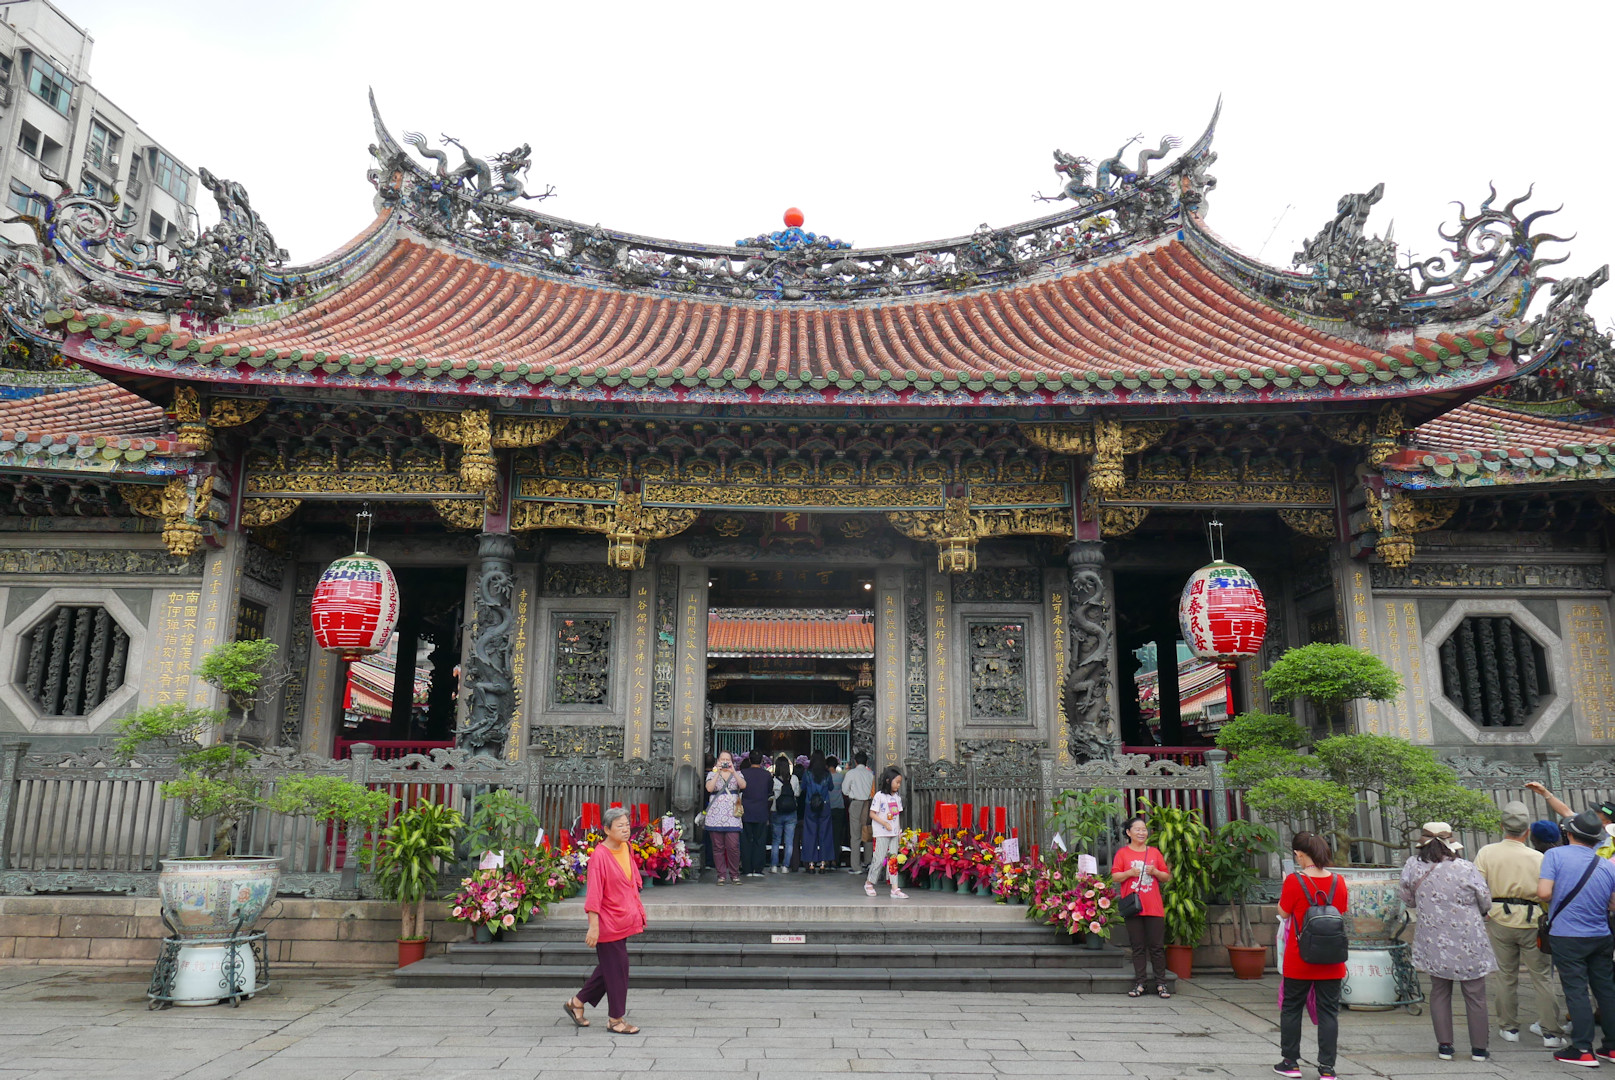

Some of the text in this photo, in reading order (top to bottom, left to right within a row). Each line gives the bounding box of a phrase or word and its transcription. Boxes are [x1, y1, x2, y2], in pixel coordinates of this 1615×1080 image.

[781, 511, 801, 531] 寺
[1189, 579, 1212, 651] 國泰民安
